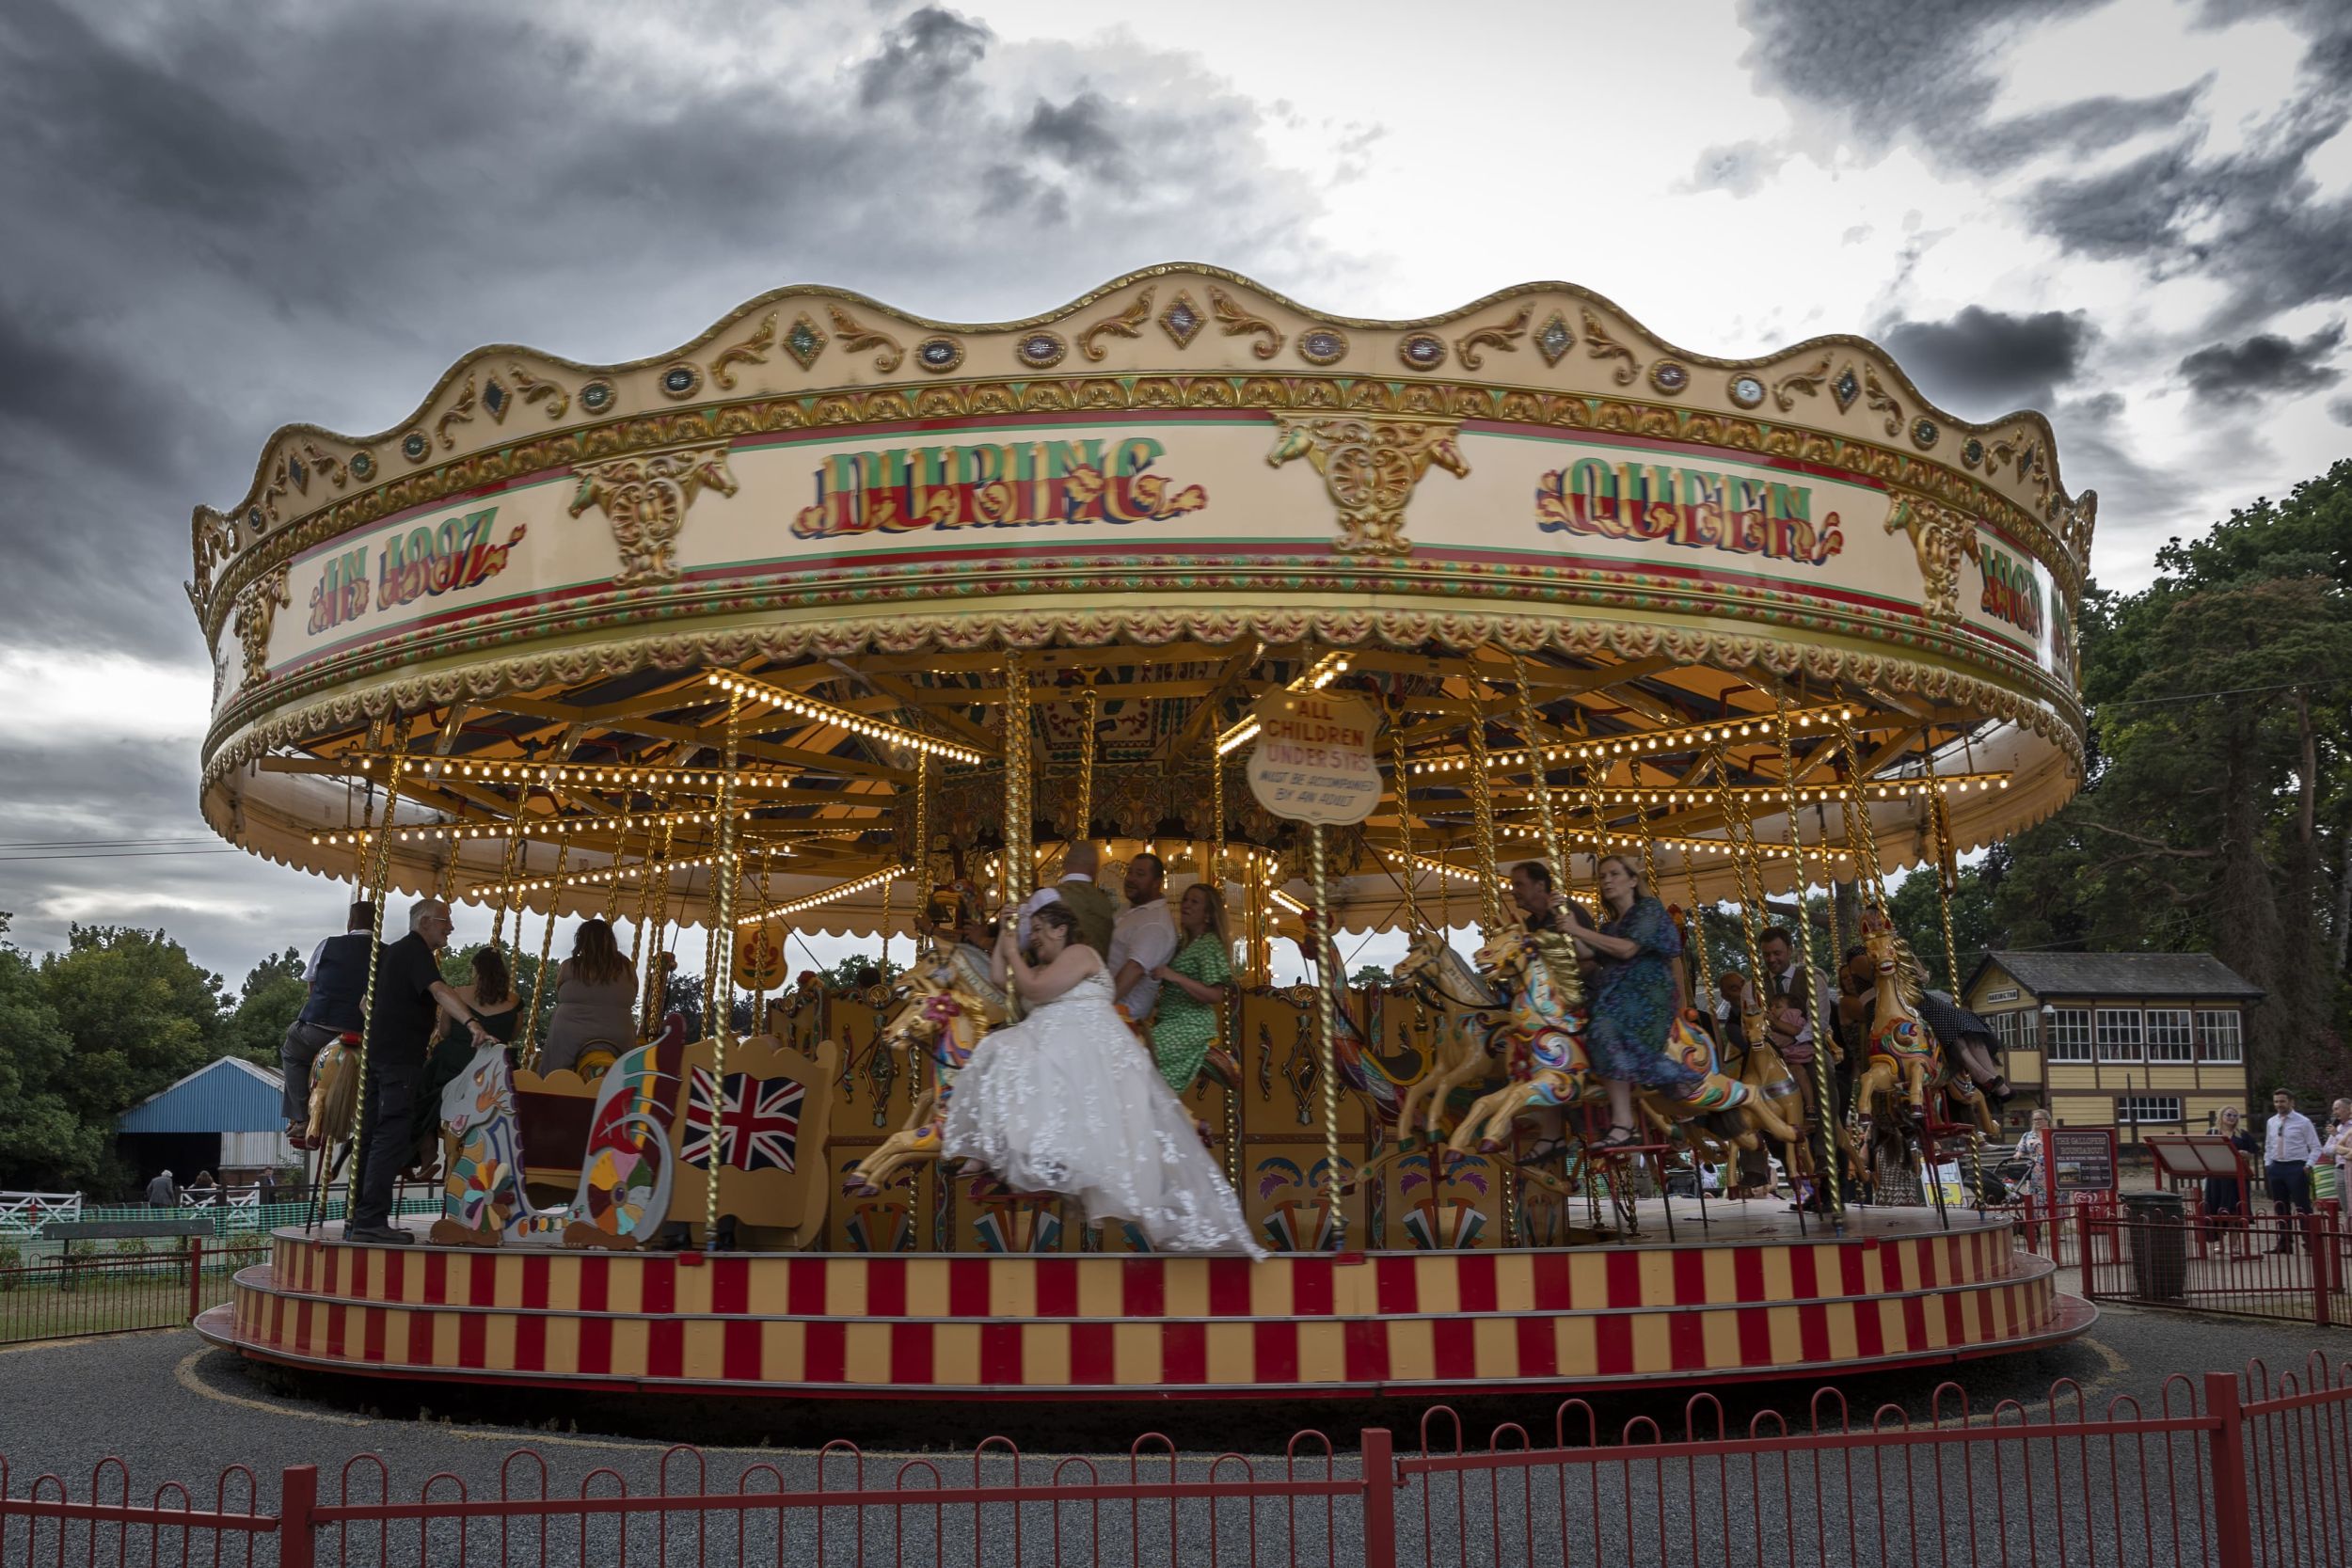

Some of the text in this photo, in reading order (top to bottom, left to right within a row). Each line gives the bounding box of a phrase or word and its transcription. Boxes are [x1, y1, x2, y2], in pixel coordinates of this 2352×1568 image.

[791, 436, 1208, 540] DURING
[1535, 457, 1844, 566] QUEEN
[308, 546, 370, 636] IN
[1296, 700, 1334, 721] ALL
[1267, 720, 1365, 747] CHILDREN
[1266, 745, 1328, 768] UNDER
[1259, 770, 1289, 784] MUST
[1291, 773, 1307, 785] BE
[1274, 787, 1357, 807] BY AN ADULT
